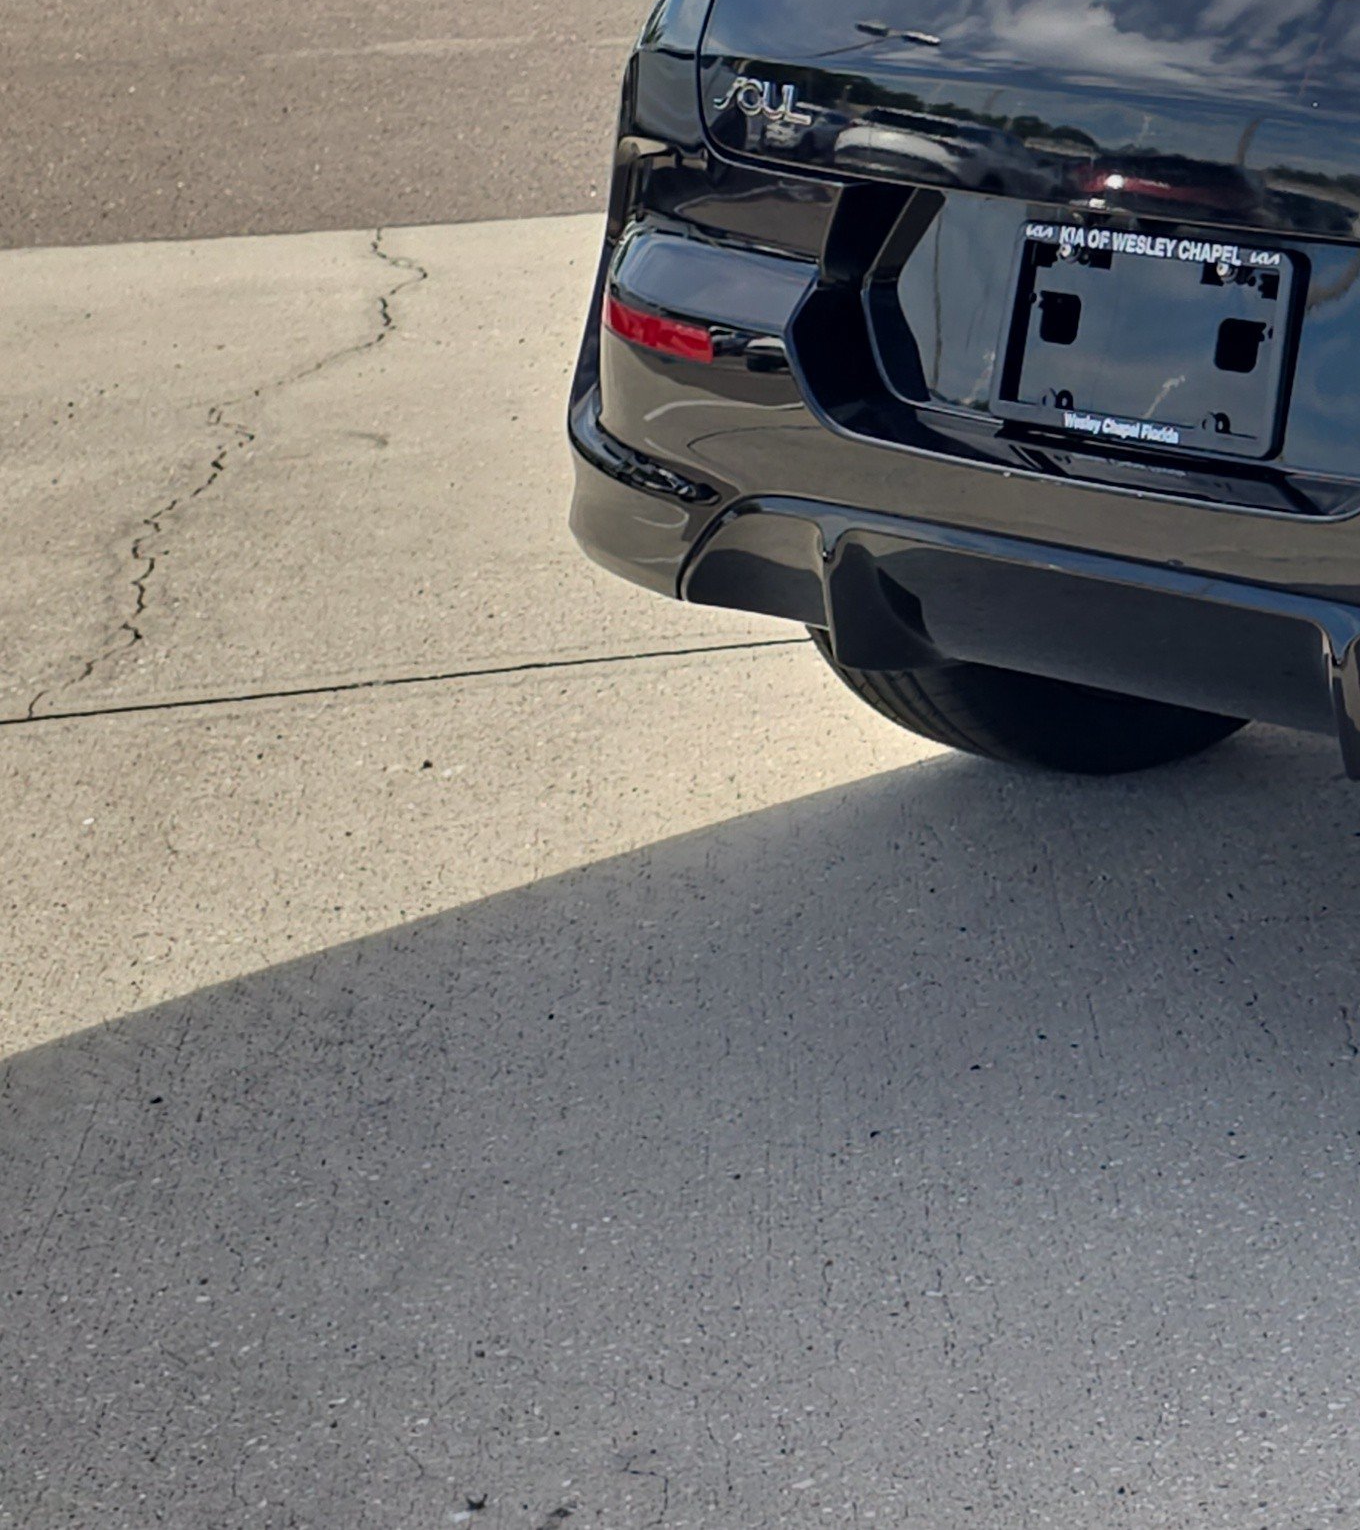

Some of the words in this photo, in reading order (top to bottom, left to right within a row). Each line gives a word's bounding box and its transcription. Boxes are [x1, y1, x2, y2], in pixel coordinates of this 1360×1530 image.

[713, 76, 812, 125] SOUL
[1059, 225, 1086, 248] KIA
[1086, 228, 1111, 250] OF
[1111, 231, 1178, 259] WESLEY
[1178, 239, 1242, 267] CHAPEL
